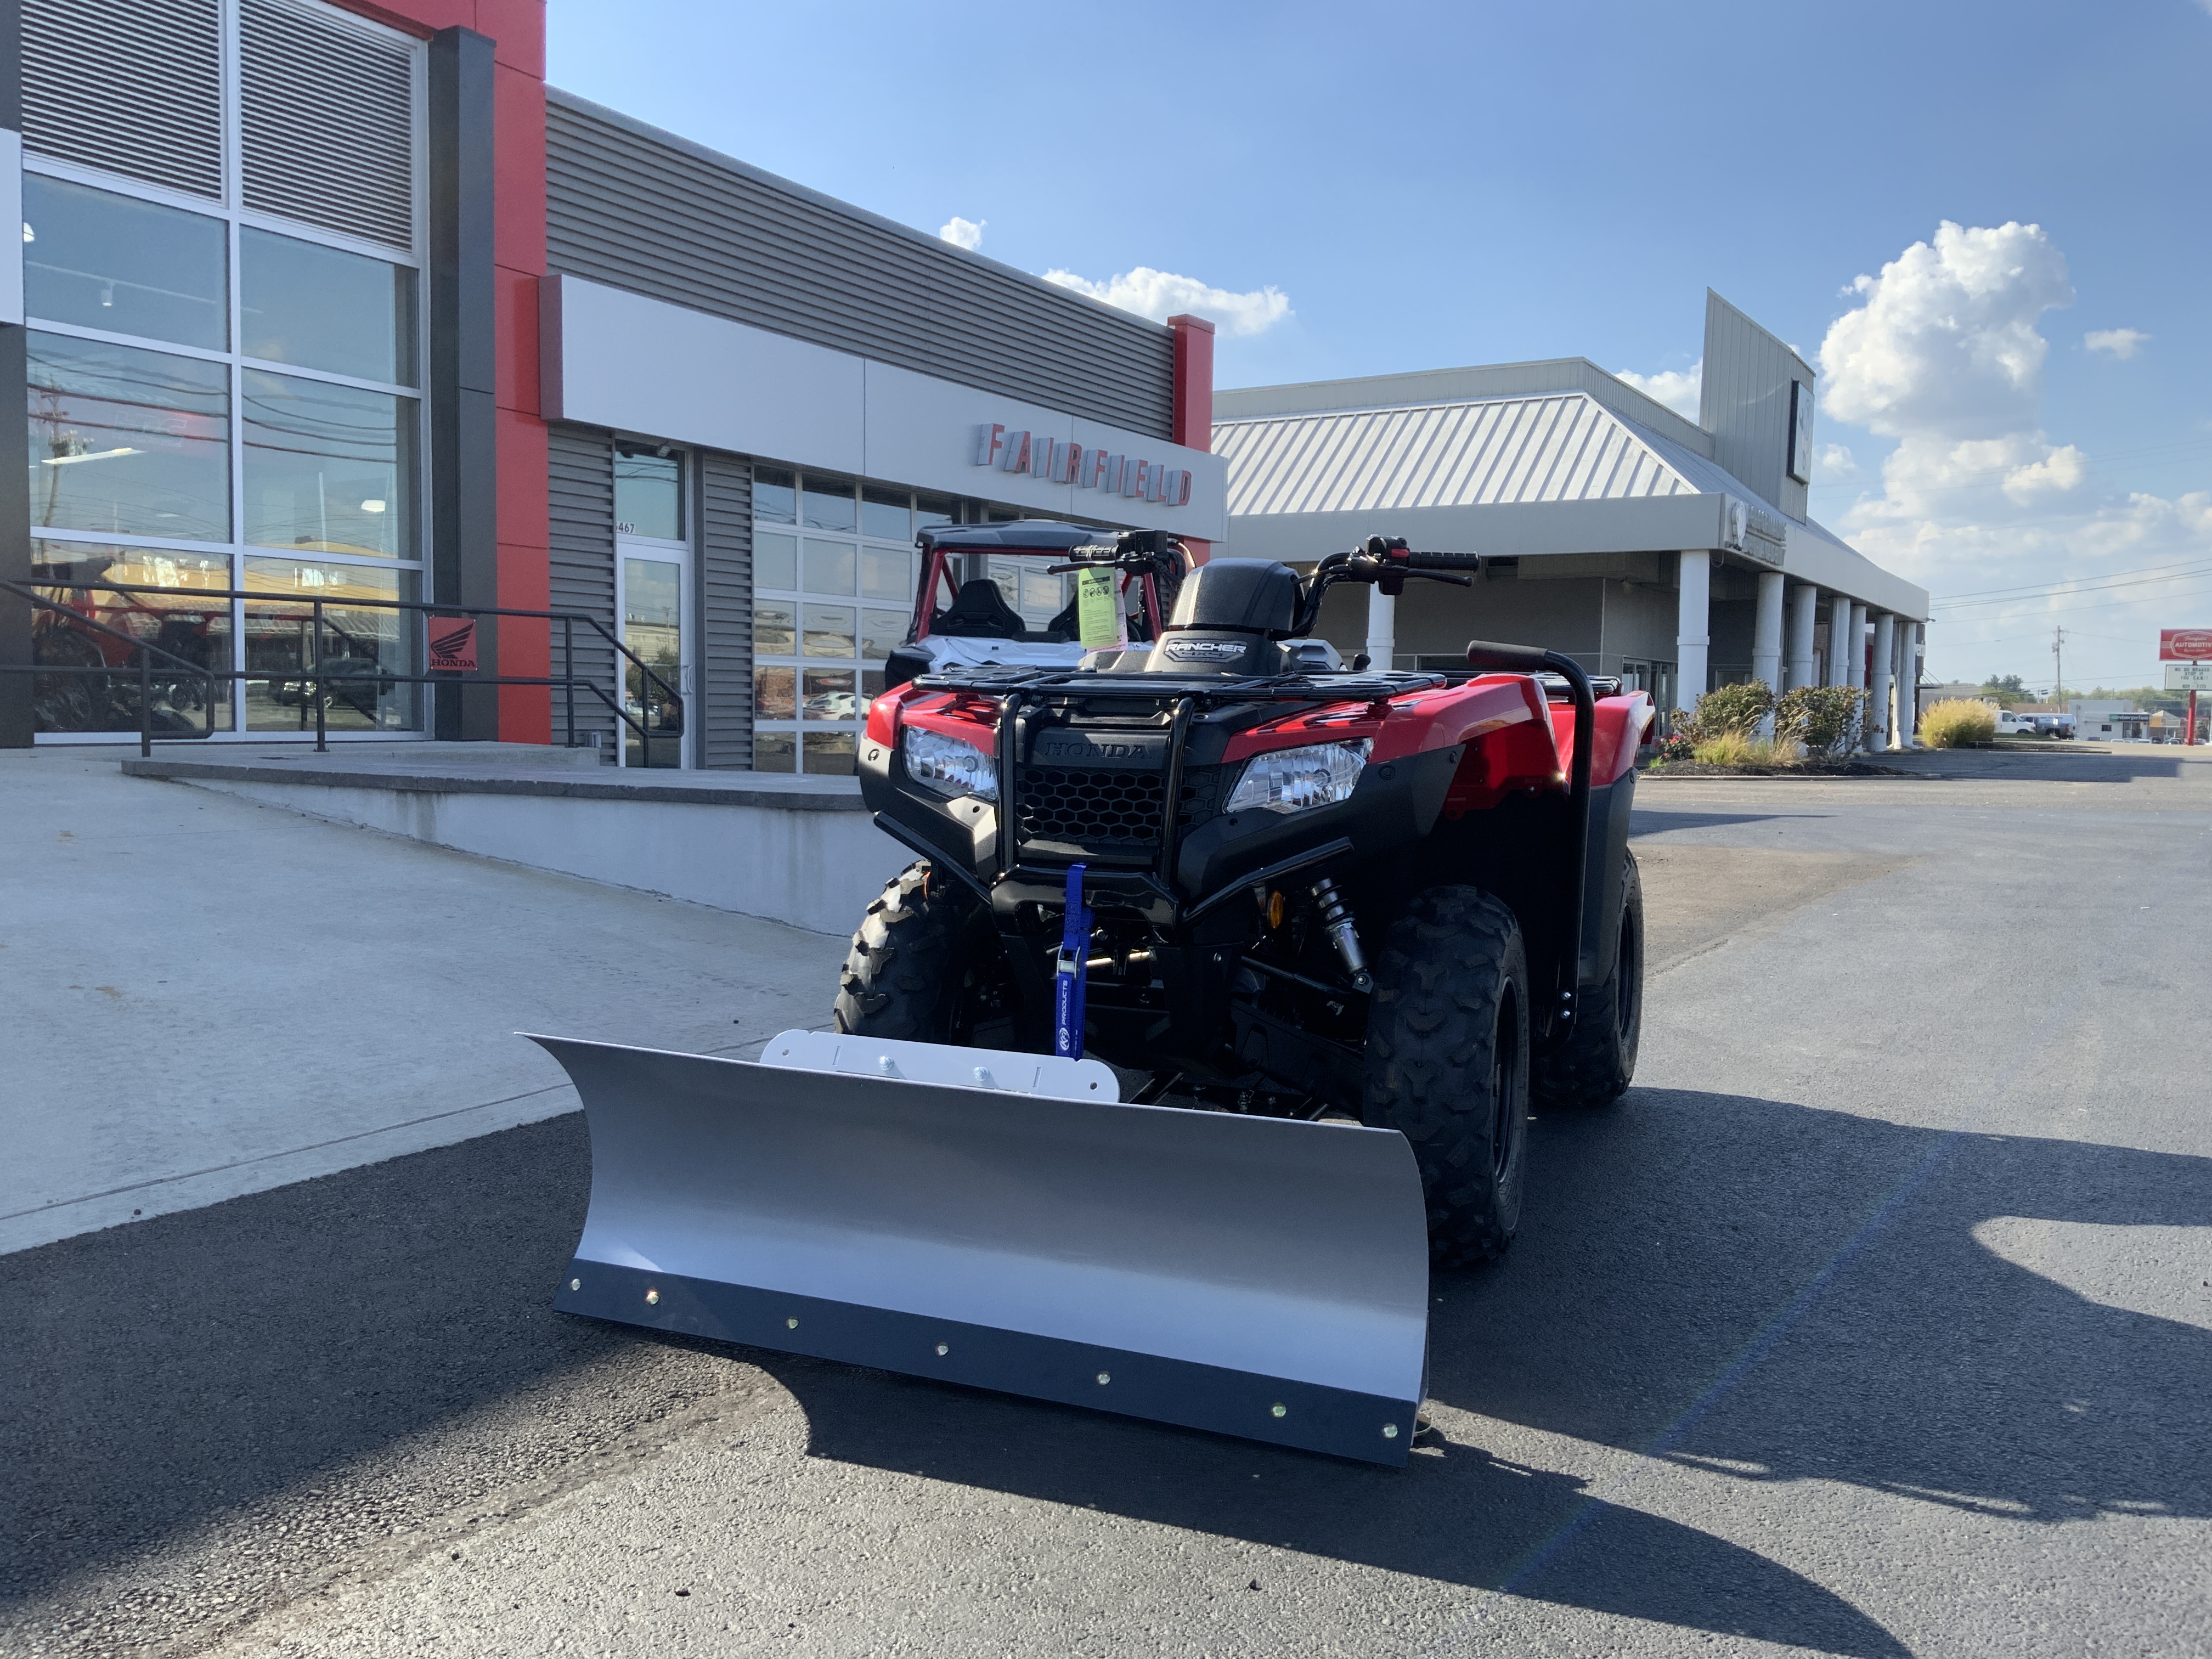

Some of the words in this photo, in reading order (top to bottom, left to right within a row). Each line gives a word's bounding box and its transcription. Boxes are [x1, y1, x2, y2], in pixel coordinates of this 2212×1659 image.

[978, 422, 1192, 506] FAIRFIELD
[616, 521, 635, 533] 467
[1165, 643, 1247, 653] RANCHER
[431, 659, 476, 667] HONDA
[1045, 742, 1152, 759] HONDA
